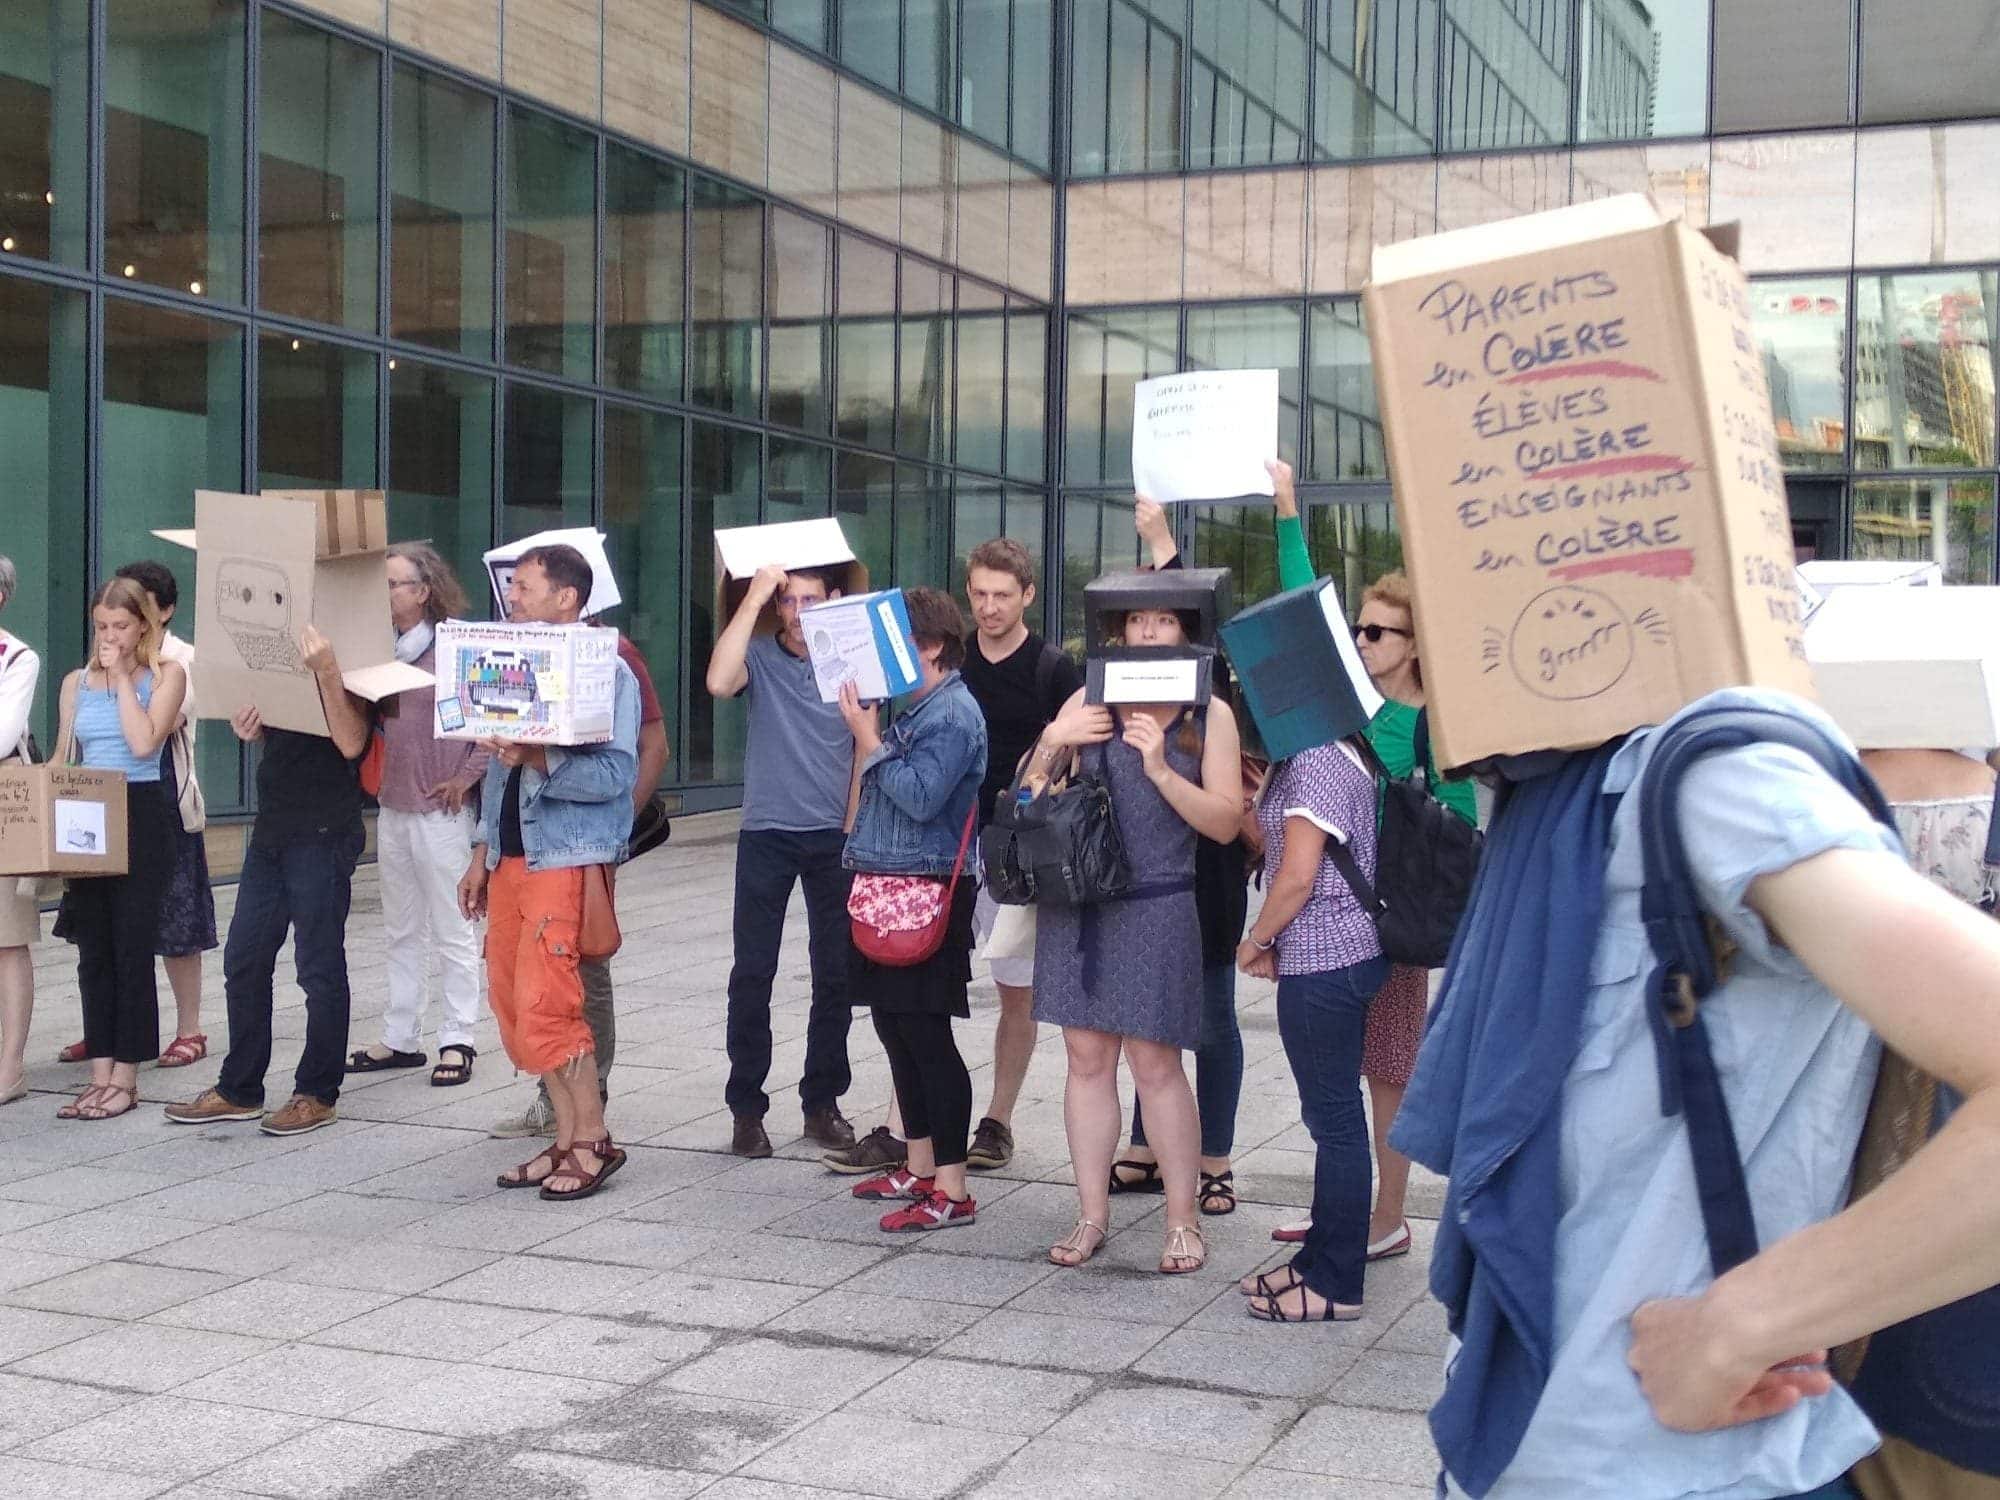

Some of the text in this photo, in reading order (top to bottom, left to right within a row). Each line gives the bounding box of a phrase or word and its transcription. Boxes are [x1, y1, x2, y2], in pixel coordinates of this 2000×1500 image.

[1418, 271, 1619, 335] PARENTS
[1423, 317, 1629, 389] en COLÈRE
[1471, 386, 1609, 439] ÉLÈVES
[1449, 423, 1652, 486] en COLÈRE
[1456, 469, 1692, 529] ENSEIGNANTS
[1473, 514, 1681, 572] en COLÈRE
